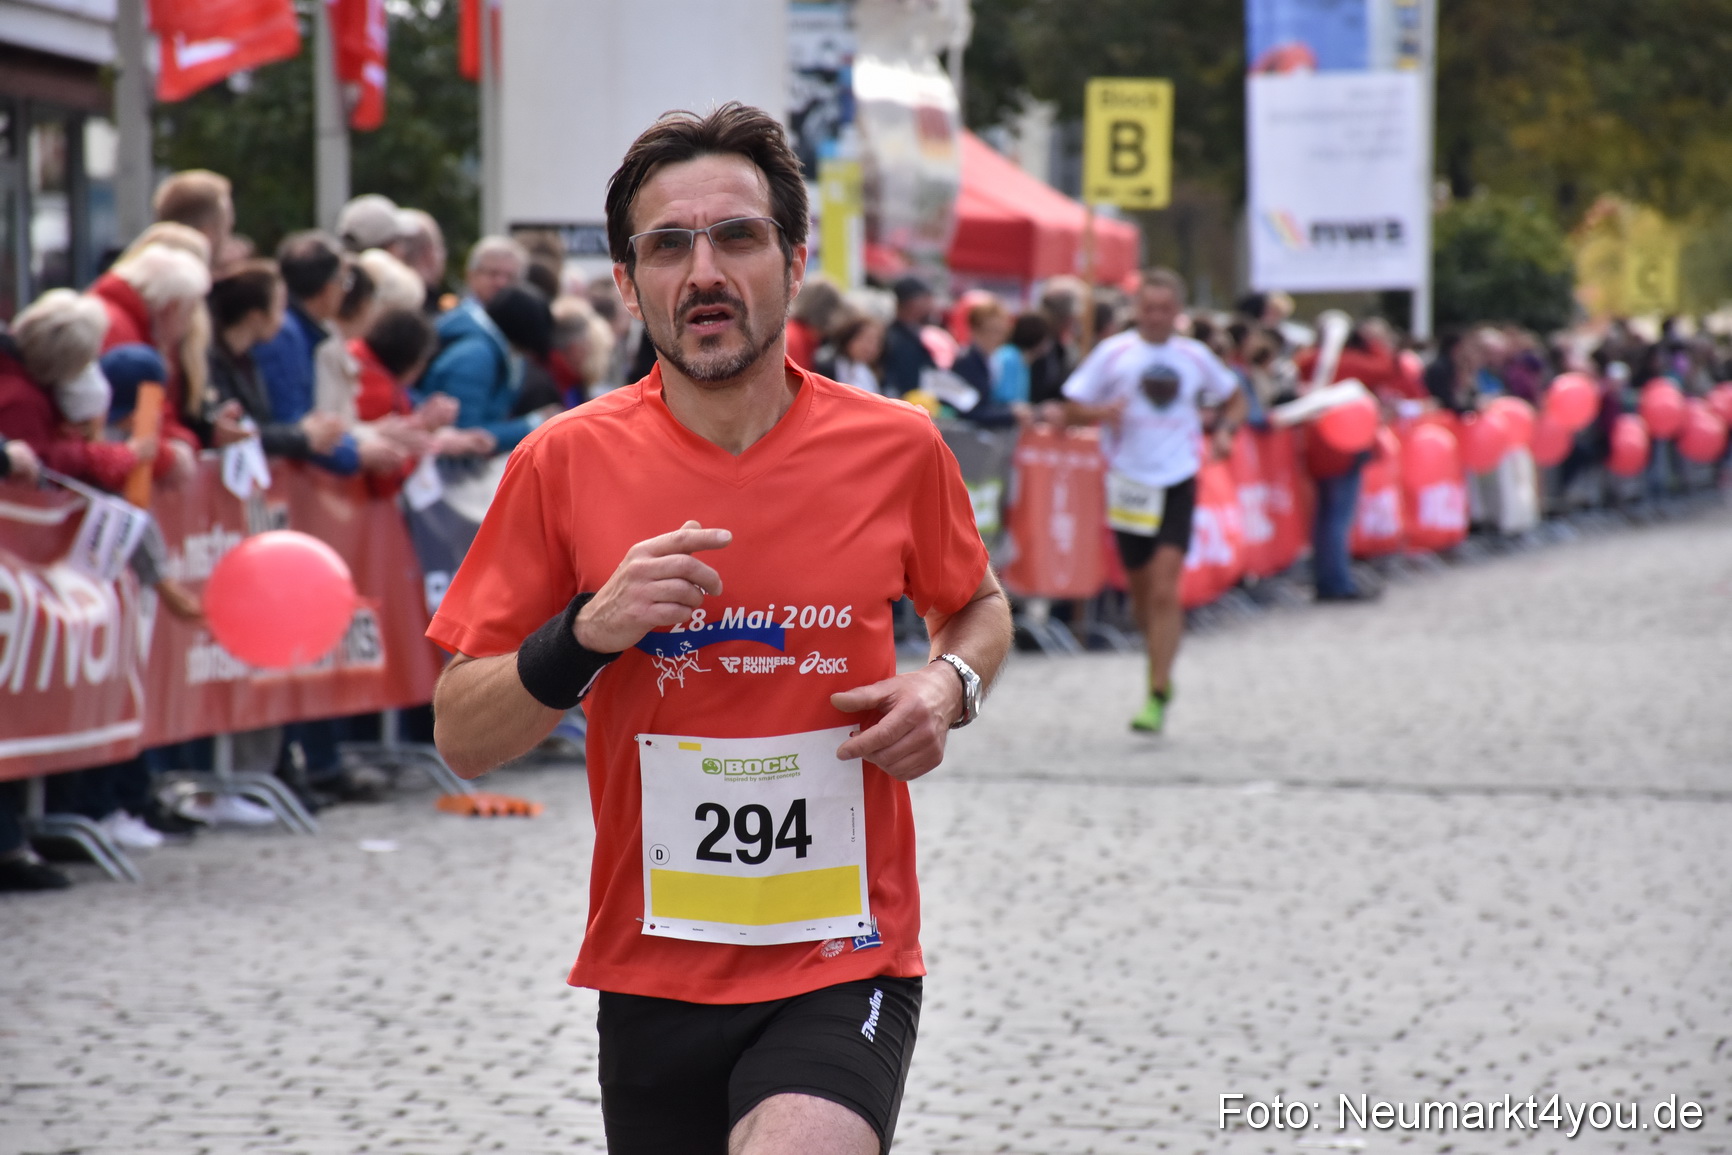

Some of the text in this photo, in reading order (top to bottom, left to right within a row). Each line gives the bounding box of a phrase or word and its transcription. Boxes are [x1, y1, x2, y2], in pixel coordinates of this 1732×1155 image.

[1108, 119, 1147, 179] B
[720, 603, 775, 630] Mai
[780, 604, 852, 629] 2006
[743, 656, 796, 666] RUNNERS
[743, 665, 776, 674] POINT
[723, 753, 800, 776] BOCK
[776, 771, 801, 780] concepts
[695, 798, 812, 865] 294
[655, 849, 664, 861] D
